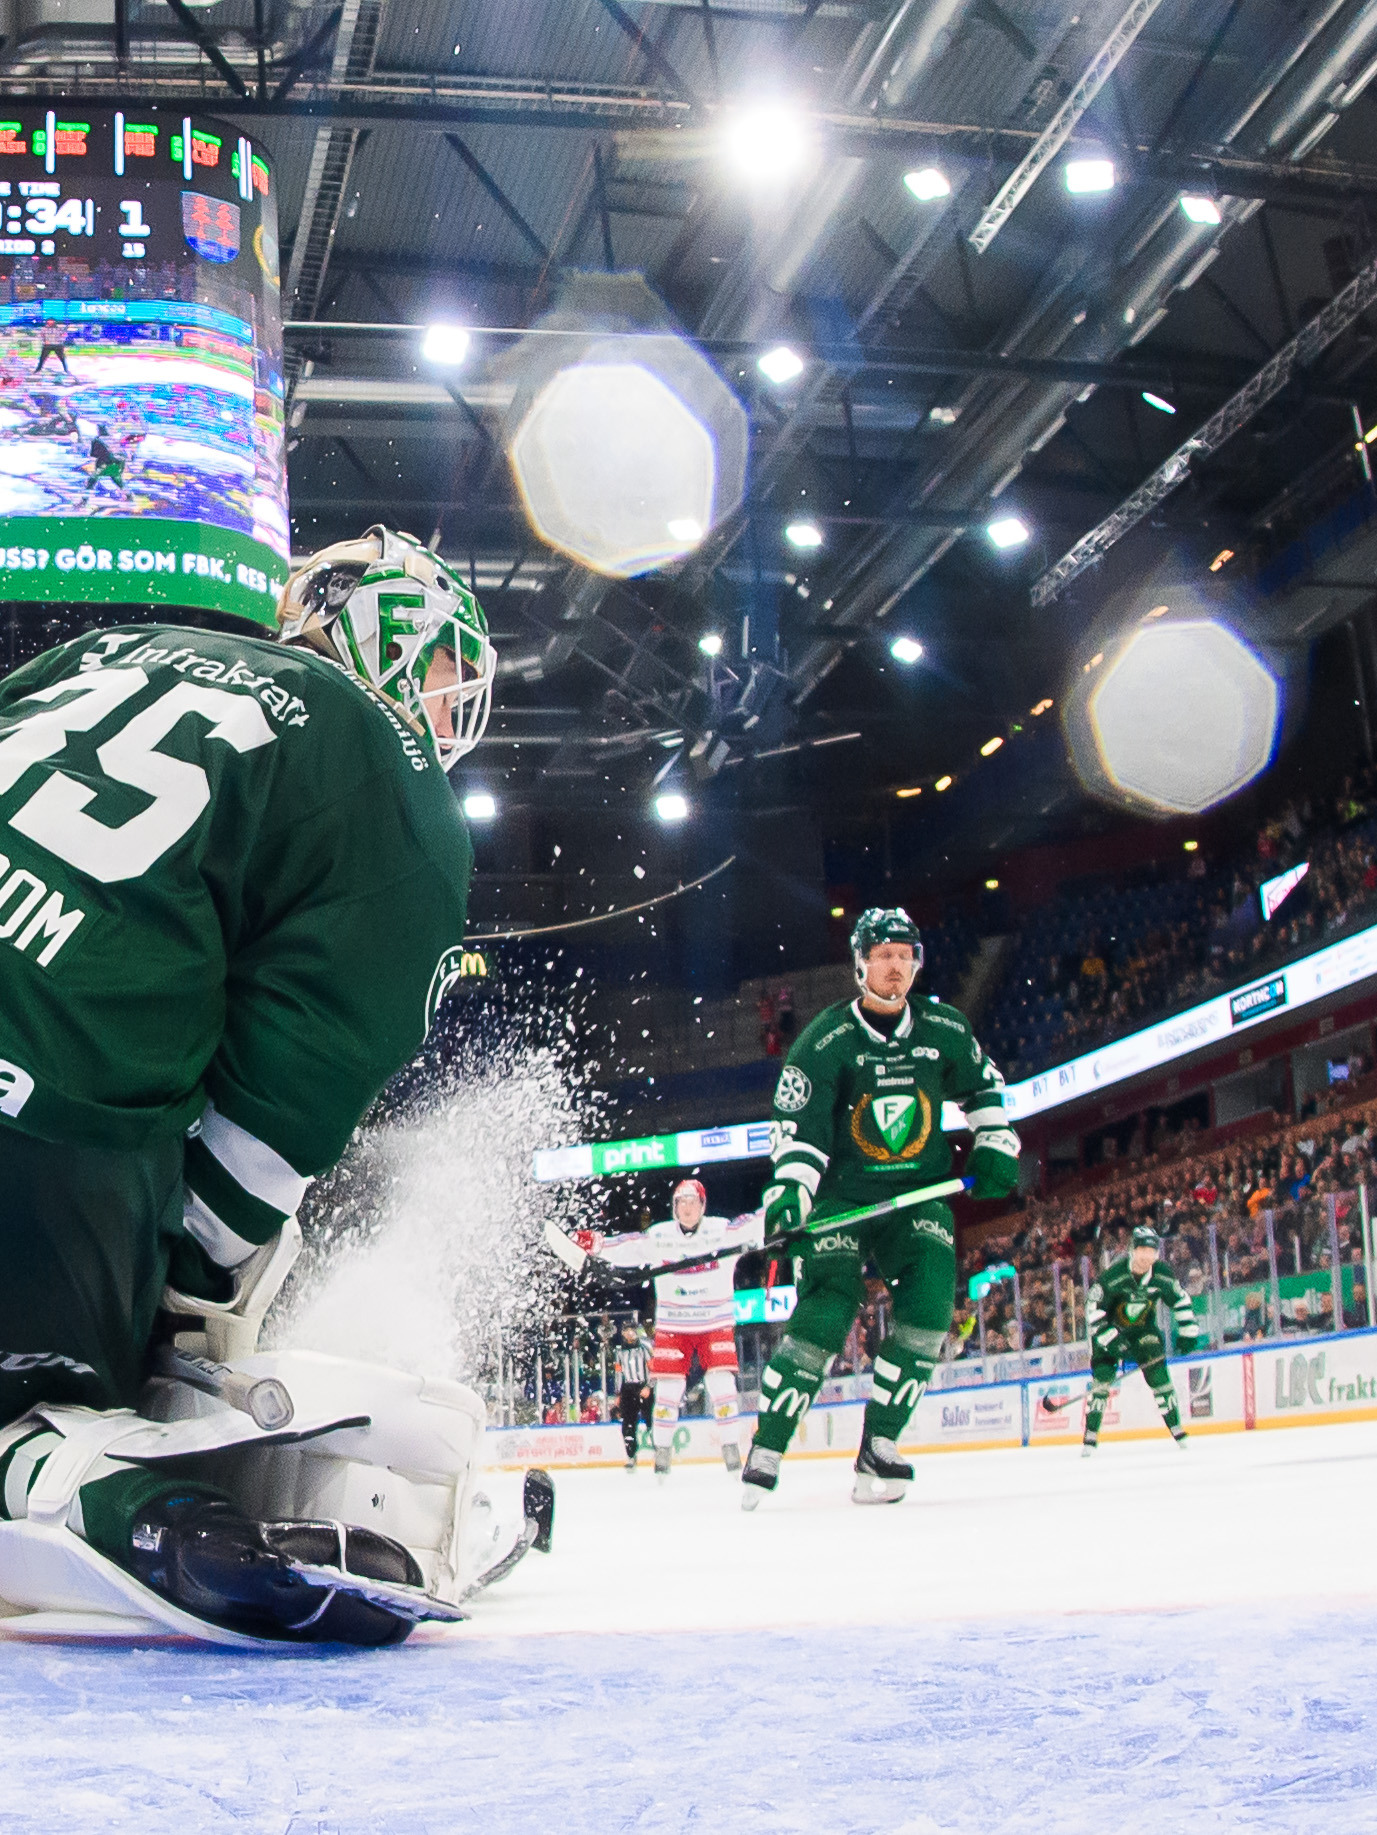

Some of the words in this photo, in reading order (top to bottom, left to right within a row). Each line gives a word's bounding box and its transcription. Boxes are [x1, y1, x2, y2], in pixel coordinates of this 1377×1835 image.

[18, 182, 60, 197] TIME
[118, 200, 150, 237] 1
[55, 544, 113, 571] GÖR
[117, 550, 176, 573] SOM
[182, 553, 232, 584] FBK,
[236, 563, 267, 593] RES
[118, 644, 310, 727] Infrakraft
[884, 1103, 898, 1125] F
[605, 1141, 665, 1171] print
